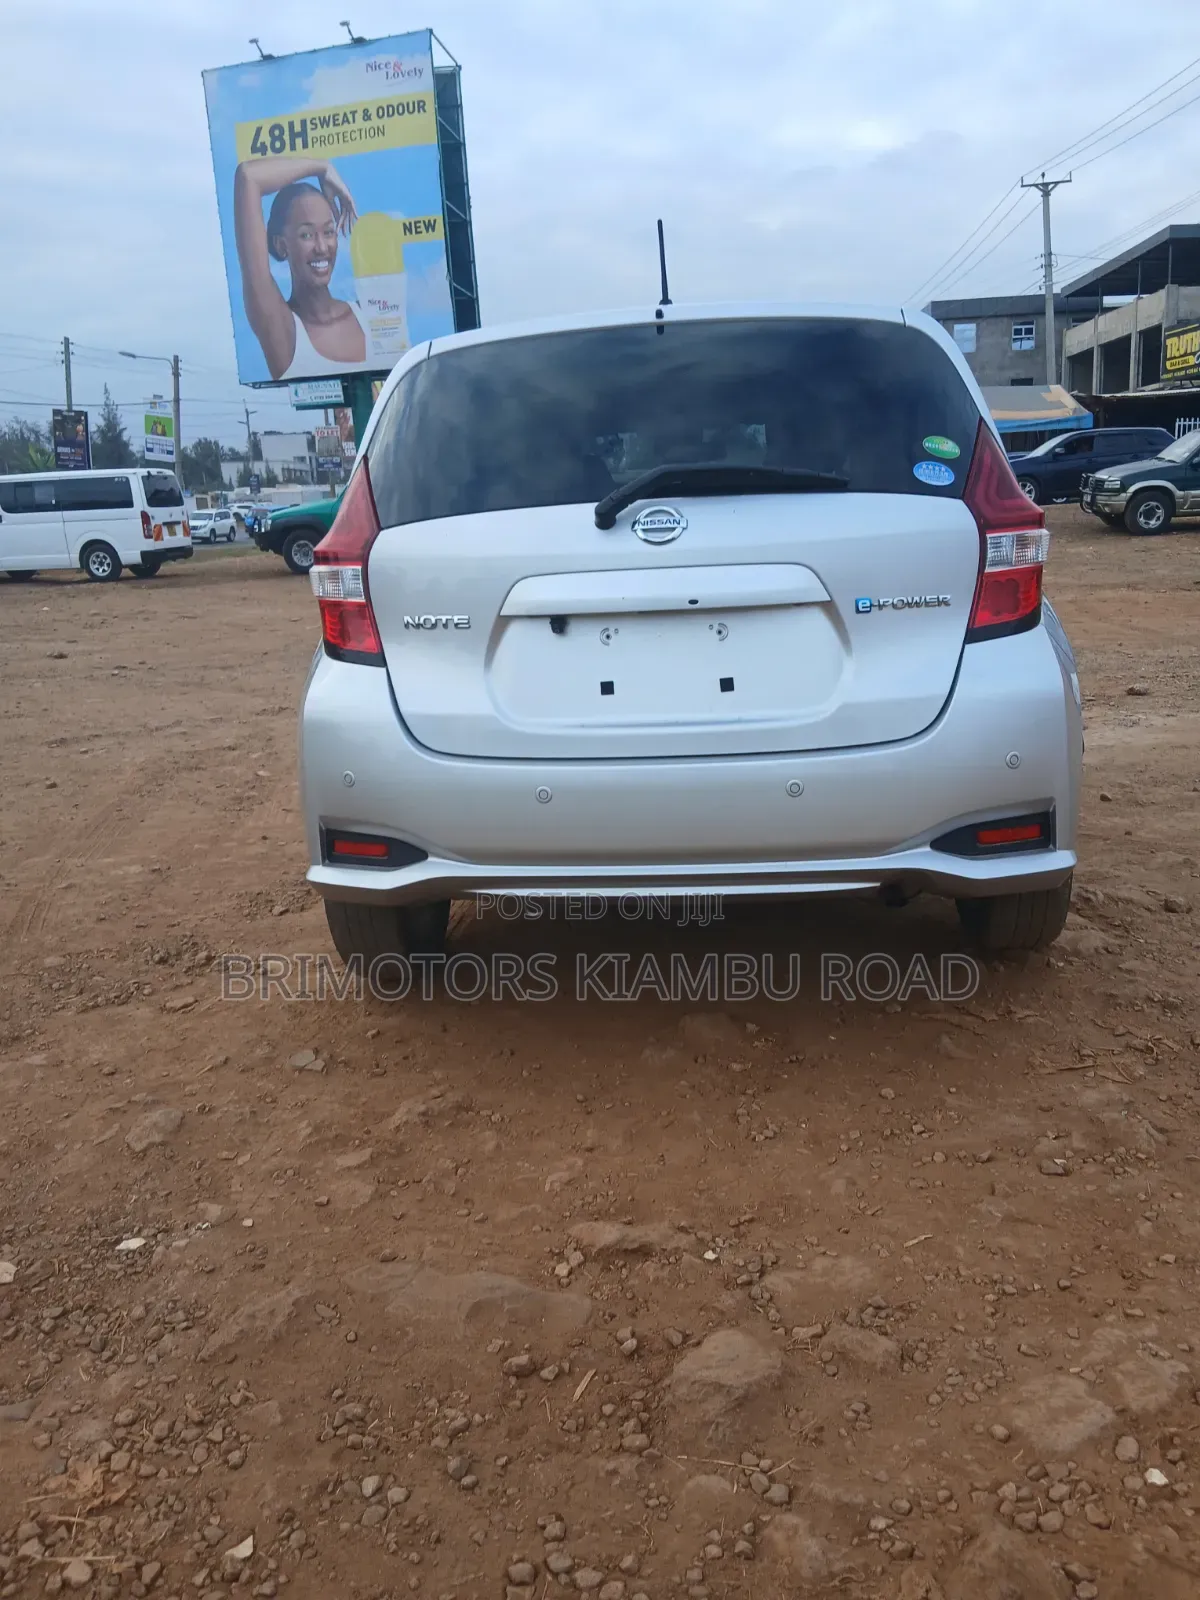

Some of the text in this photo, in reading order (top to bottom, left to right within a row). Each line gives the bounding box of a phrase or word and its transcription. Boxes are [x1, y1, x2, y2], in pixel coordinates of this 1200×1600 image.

[366, 60, 403, 73] Nice &
[385, 67, 424, 80] Lovely
[310, 100, 427, 131] SWEAT & ODOUR
[250, 118, 309, 157] 48H
[311, 124, 386, 148] PROTECTION
[402, 218, 437, 236] NEW
[637, 518, 681, 527] NISSAN
[403, 614, 471, 630] NOTE
